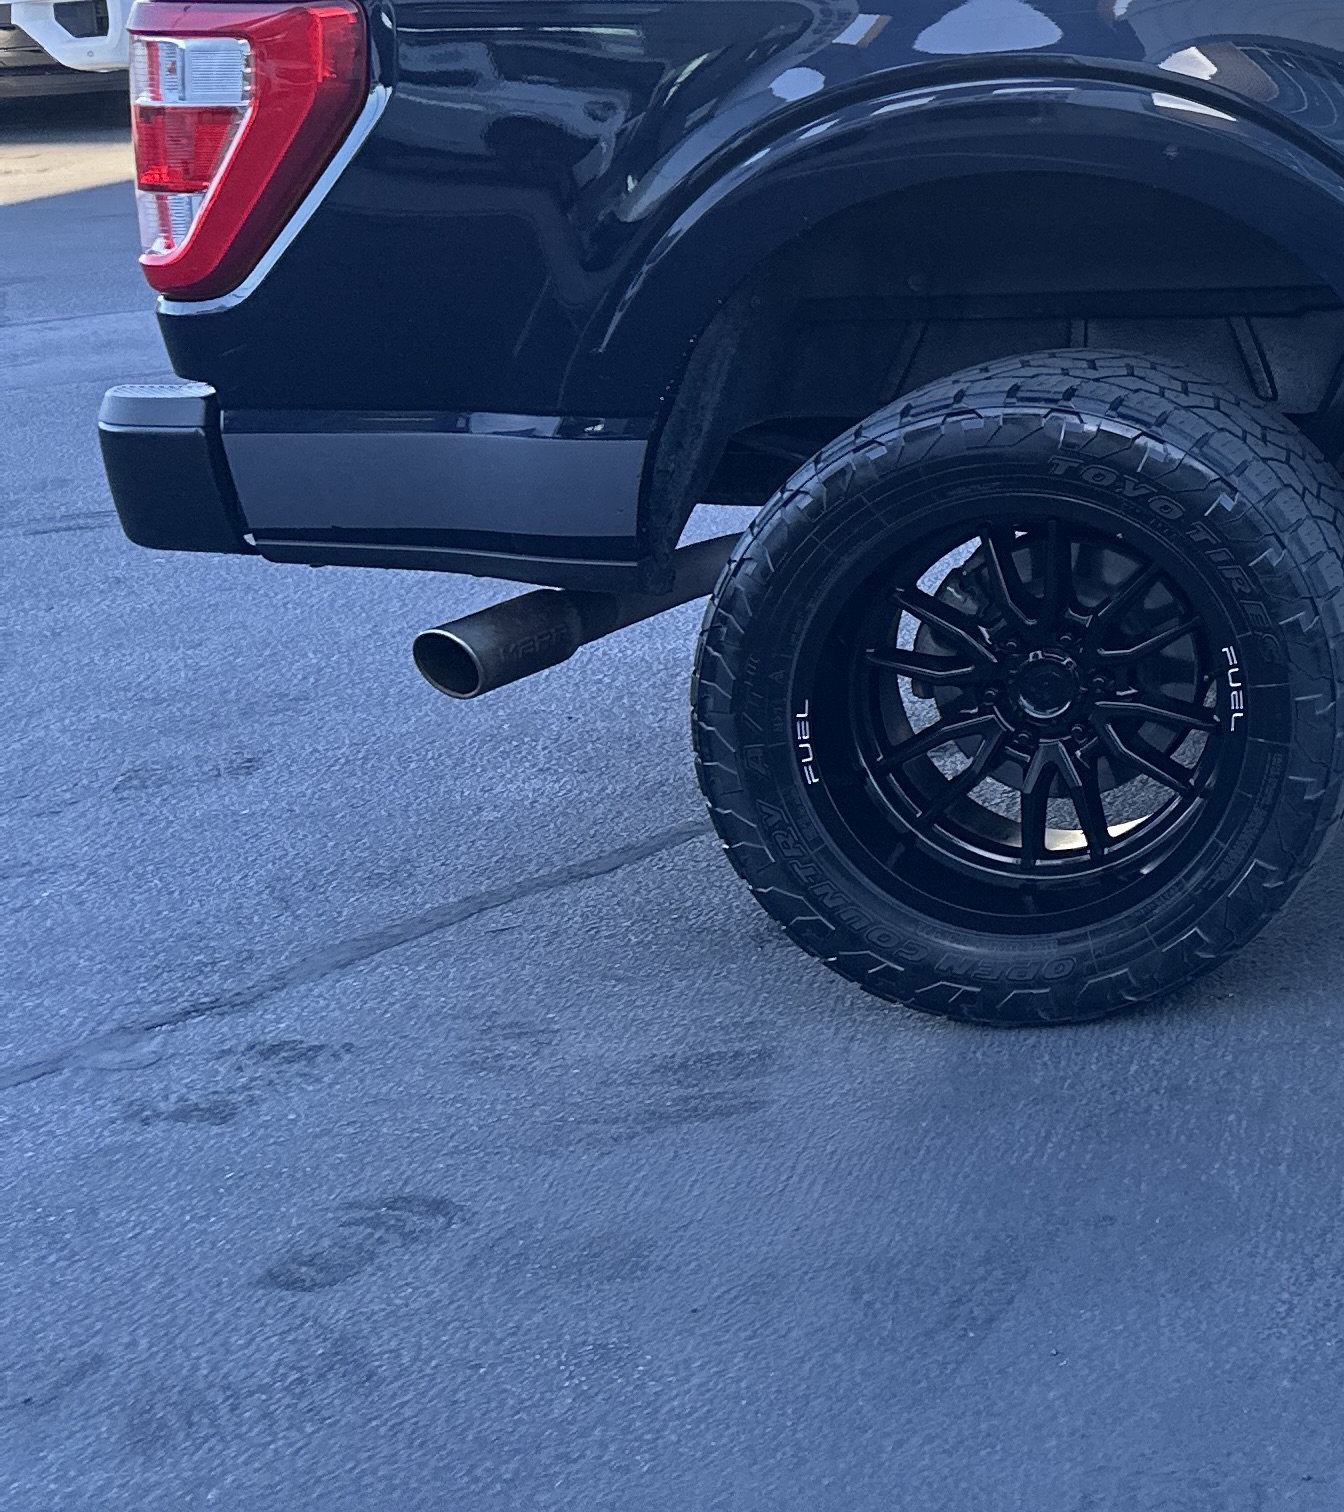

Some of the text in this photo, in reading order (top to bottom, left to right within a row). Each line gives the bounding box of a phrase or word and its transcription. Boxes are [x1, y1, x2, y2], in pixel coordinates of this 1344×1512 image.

[1047, 454, 1187, 520] TOYO
[1221, 645, 1244, 732] FUEL
[795, 698, 820, 784] FUEL
[756, 799, 931, 961] COUNTRY
[934, 951, 1078, 982] OPEN
